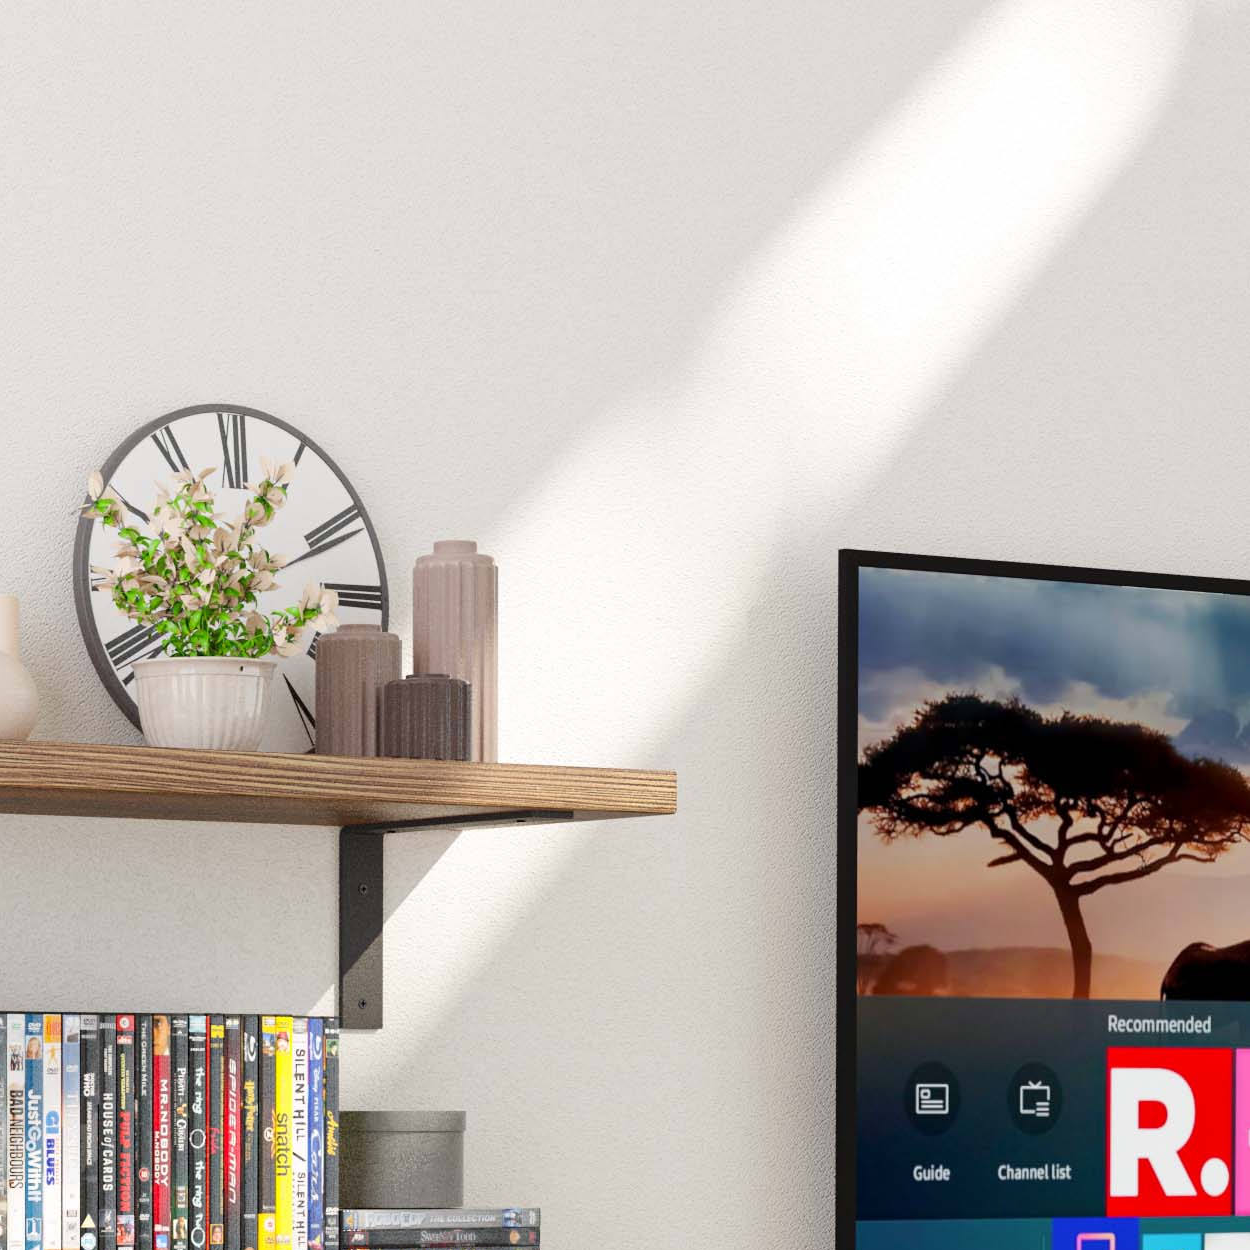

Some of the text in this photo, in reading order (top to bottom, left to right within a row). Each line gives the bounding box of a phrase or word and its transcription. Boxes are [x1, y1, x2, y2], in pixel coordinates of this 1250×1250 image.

[1108, 1014, 1211, 1033] Recommended
[83, 1072, 91, 1097] WHO
[194, 1066, 204, 1087] the
[294, 1048, 305, 1105] SILENT
[311, 1068, 320, 1093] Disney
[192, 1091, 204, 1115] ring
[244, 1079, 255, 1103] Harry
[228, 1058, 237, 1205] SPIDER-MAN
[244, 1104, 258, 1132] Potter
[293, 1109, 306, 1141] HILL
[10, 1090, 23, 1189] BAD NEIGHBOURS
[101, 1092, 114, 1191] HOUSE of CARDS
[160, 1079, 168, 1188] MR.NOBODY
[209, 1127, 221, 1155] Frida
[276, 1112, 290, 1176] snatch
[46, 1110, 59, 1186] GI BLUES
[119, 1111, 130, 1212] PULP FICTION
[194, 1160, 204, 1180] the
[309, 1128, 322, 1204] Cars
[913, 1166, 951, 1181] Guide
[998, 1163, 1071, 1180] Channel list
[192, 1185, 204, 1208] ring
[297, 1171, 305, 1218] SILENT
[447, 1215, 497, 1223] COLLECTION
[295, 1220, 305, 1247] HILL
